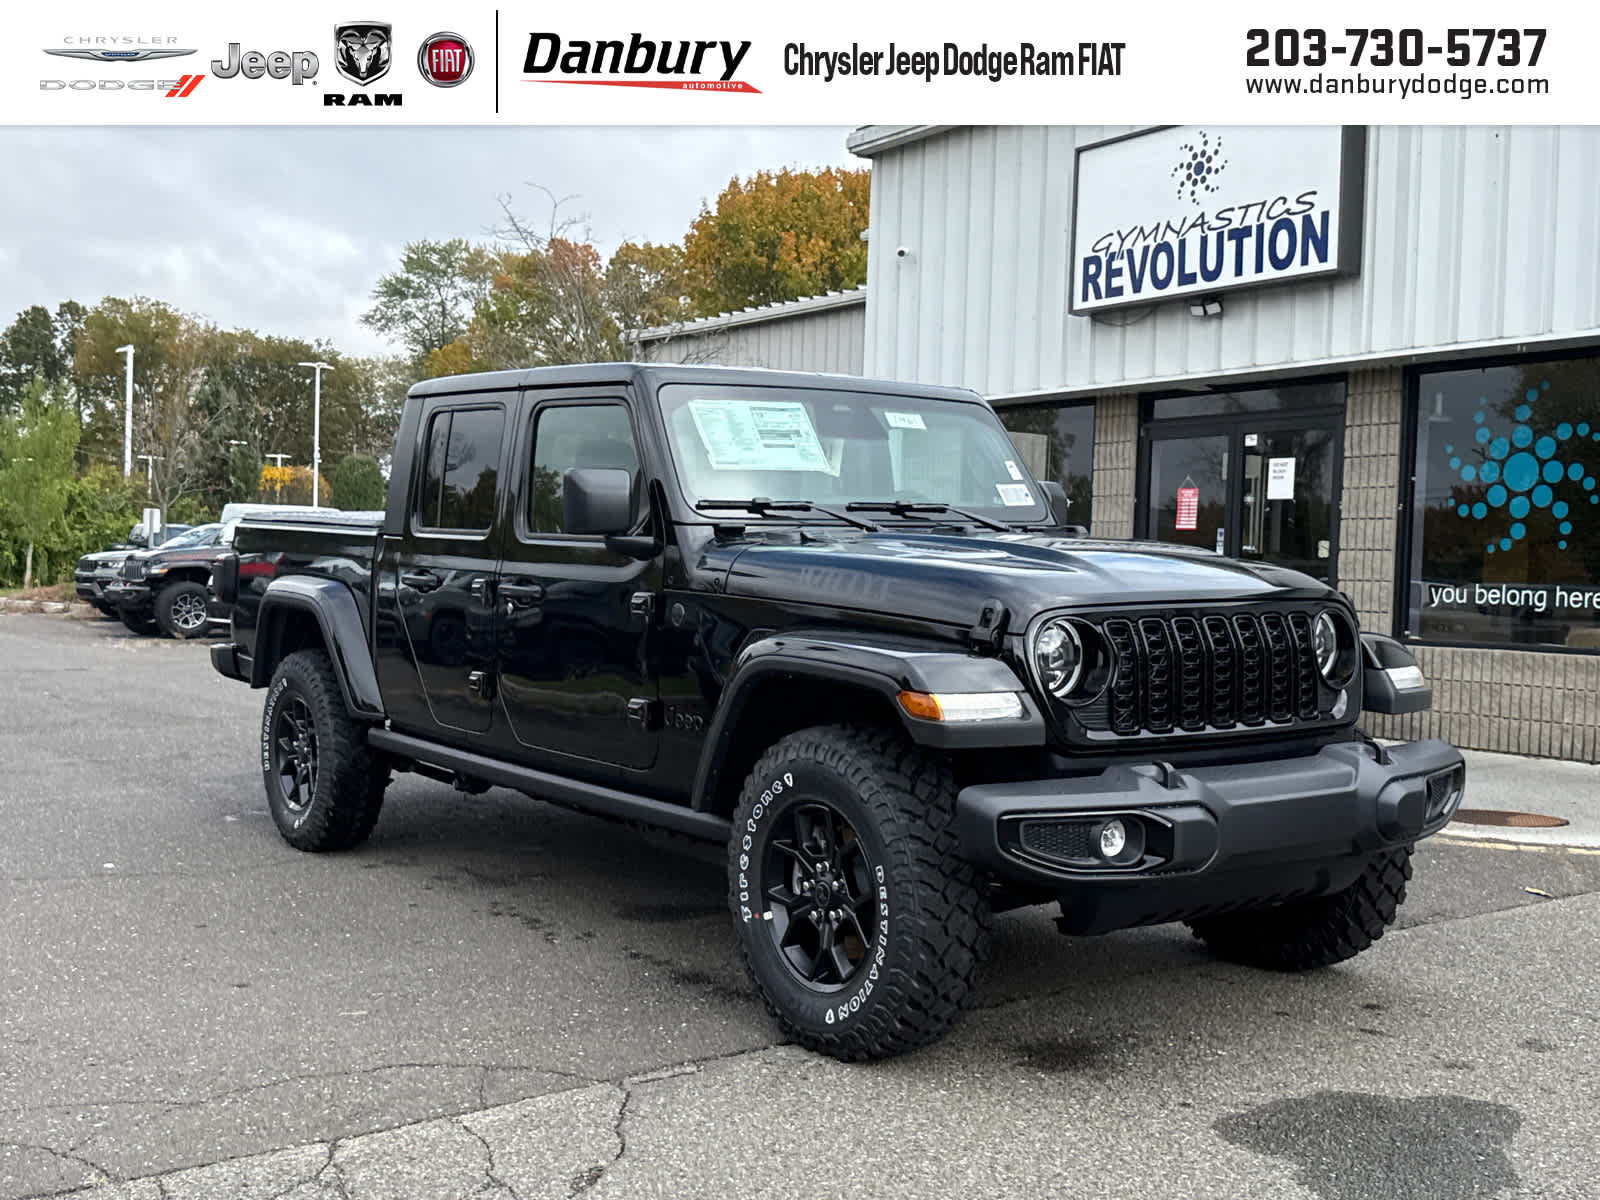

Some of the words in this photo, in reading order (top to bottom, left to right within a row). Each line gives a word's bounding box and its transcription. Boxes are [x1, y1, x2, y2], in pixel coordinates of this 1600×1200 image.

[1081, 210, 1330, 302] REVOLUTION
[1092, 190, 1317, 259] GYMNASTICS
[1431, 584, 1467, 607] you
[1475, 583, 1547, 612] belong
[1555, 585, 1600, 609] here
[838, 865, 888, 1020] DESTINATION
